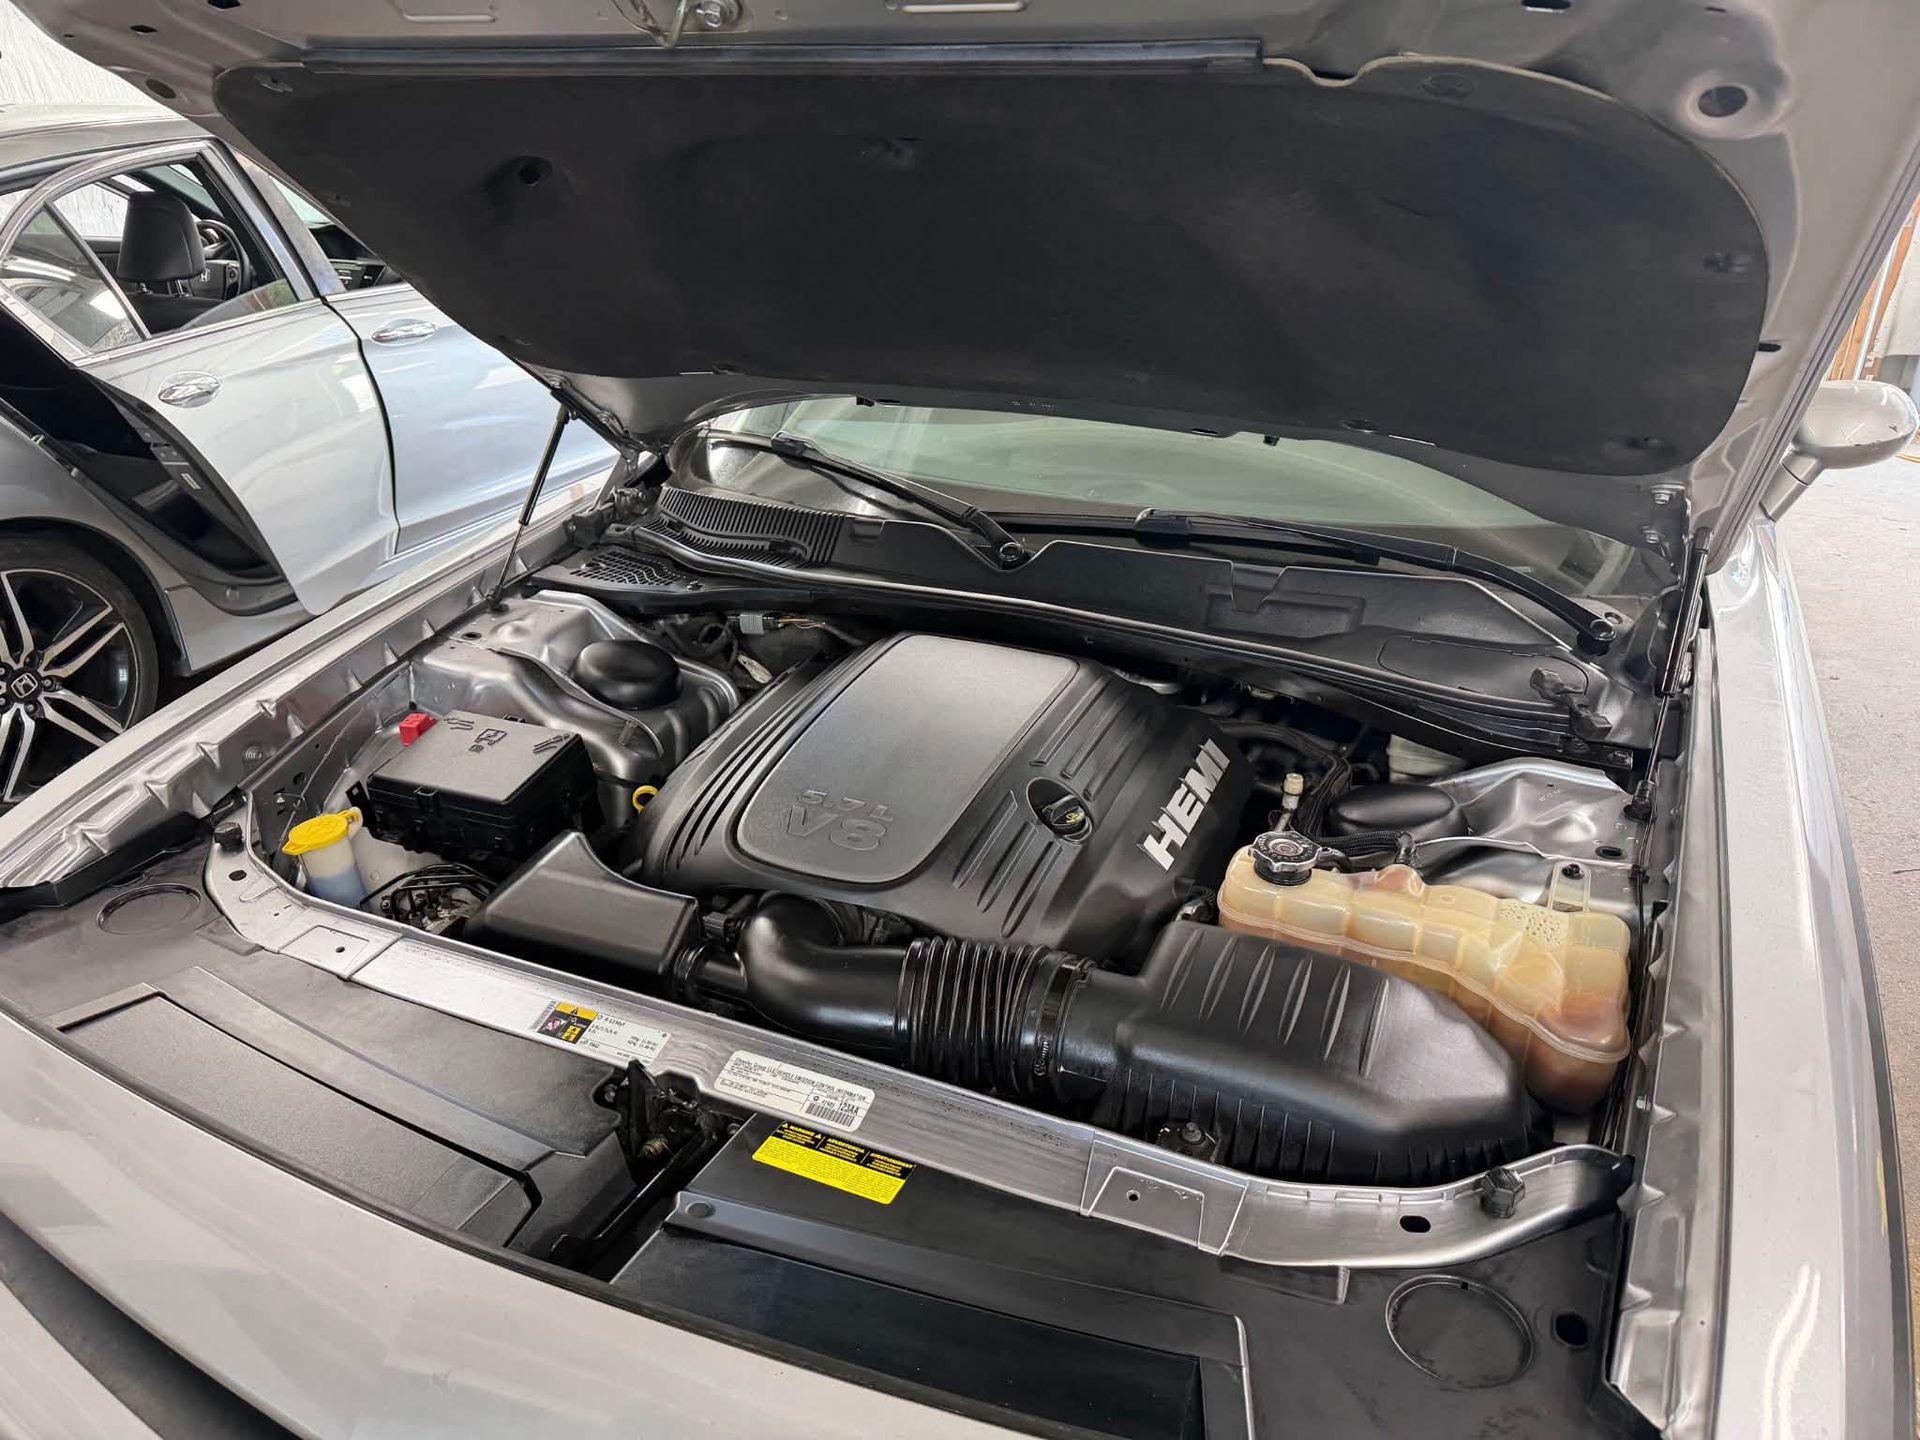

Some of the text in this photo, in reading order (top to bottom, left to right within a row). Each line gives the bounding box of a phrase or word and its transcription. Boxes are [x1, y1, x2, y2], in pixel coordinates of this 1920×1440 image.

[786, 803, 887, 851] V8
[1139, 738, 1231, 871] HEMI
[838, 1102, 860, 1116] 123AA
